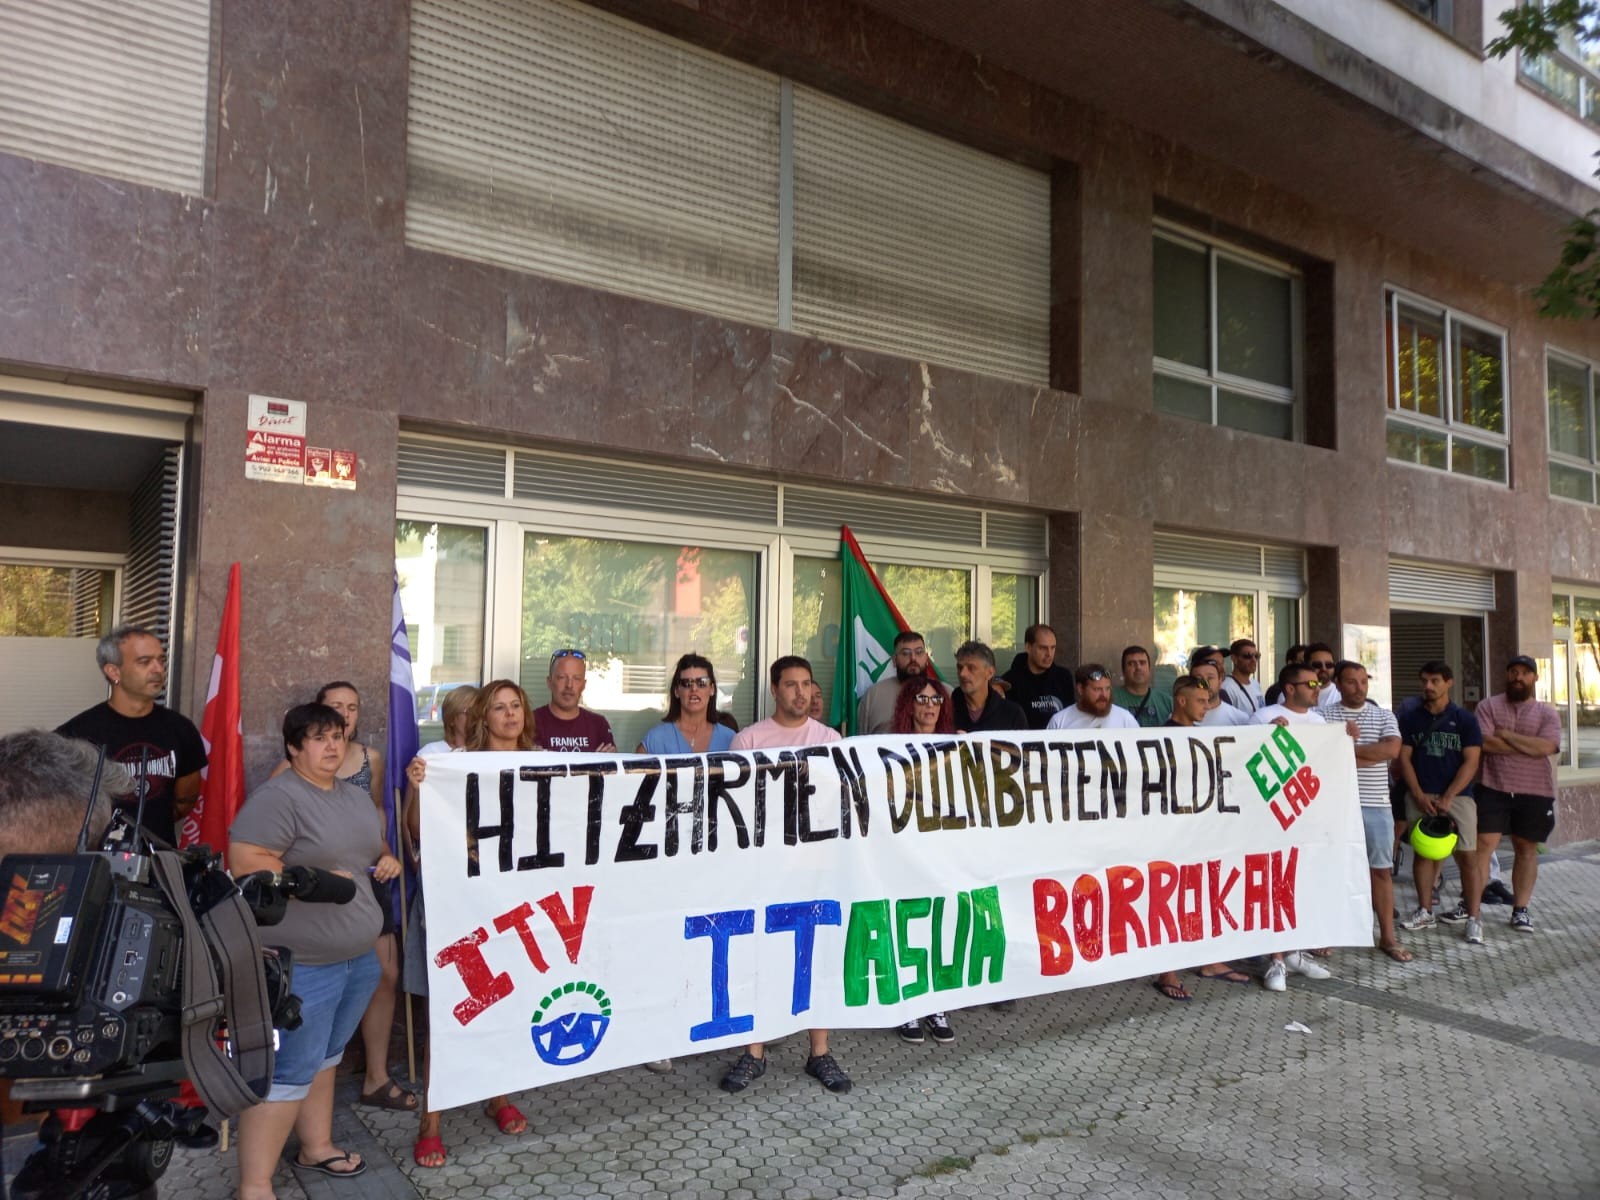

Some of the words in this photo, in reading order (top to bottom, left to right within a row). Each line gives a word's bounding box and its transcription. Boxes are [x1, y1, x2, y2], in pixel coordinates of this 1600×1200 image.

[252, 431, 301, 447] Alarma
[550, 736, 590, 747] FRANKIE
[1245, 724, 1306, 802] ELA
[466, 746, 870, 878] HITZARMEN
[1136, 737, 1241, 815] ALDE
[1270, 766, 1321, 831] LAB
[1032, 846, 1299, 976] BORROKAN
[434, 885, 595, 1026] ITV
